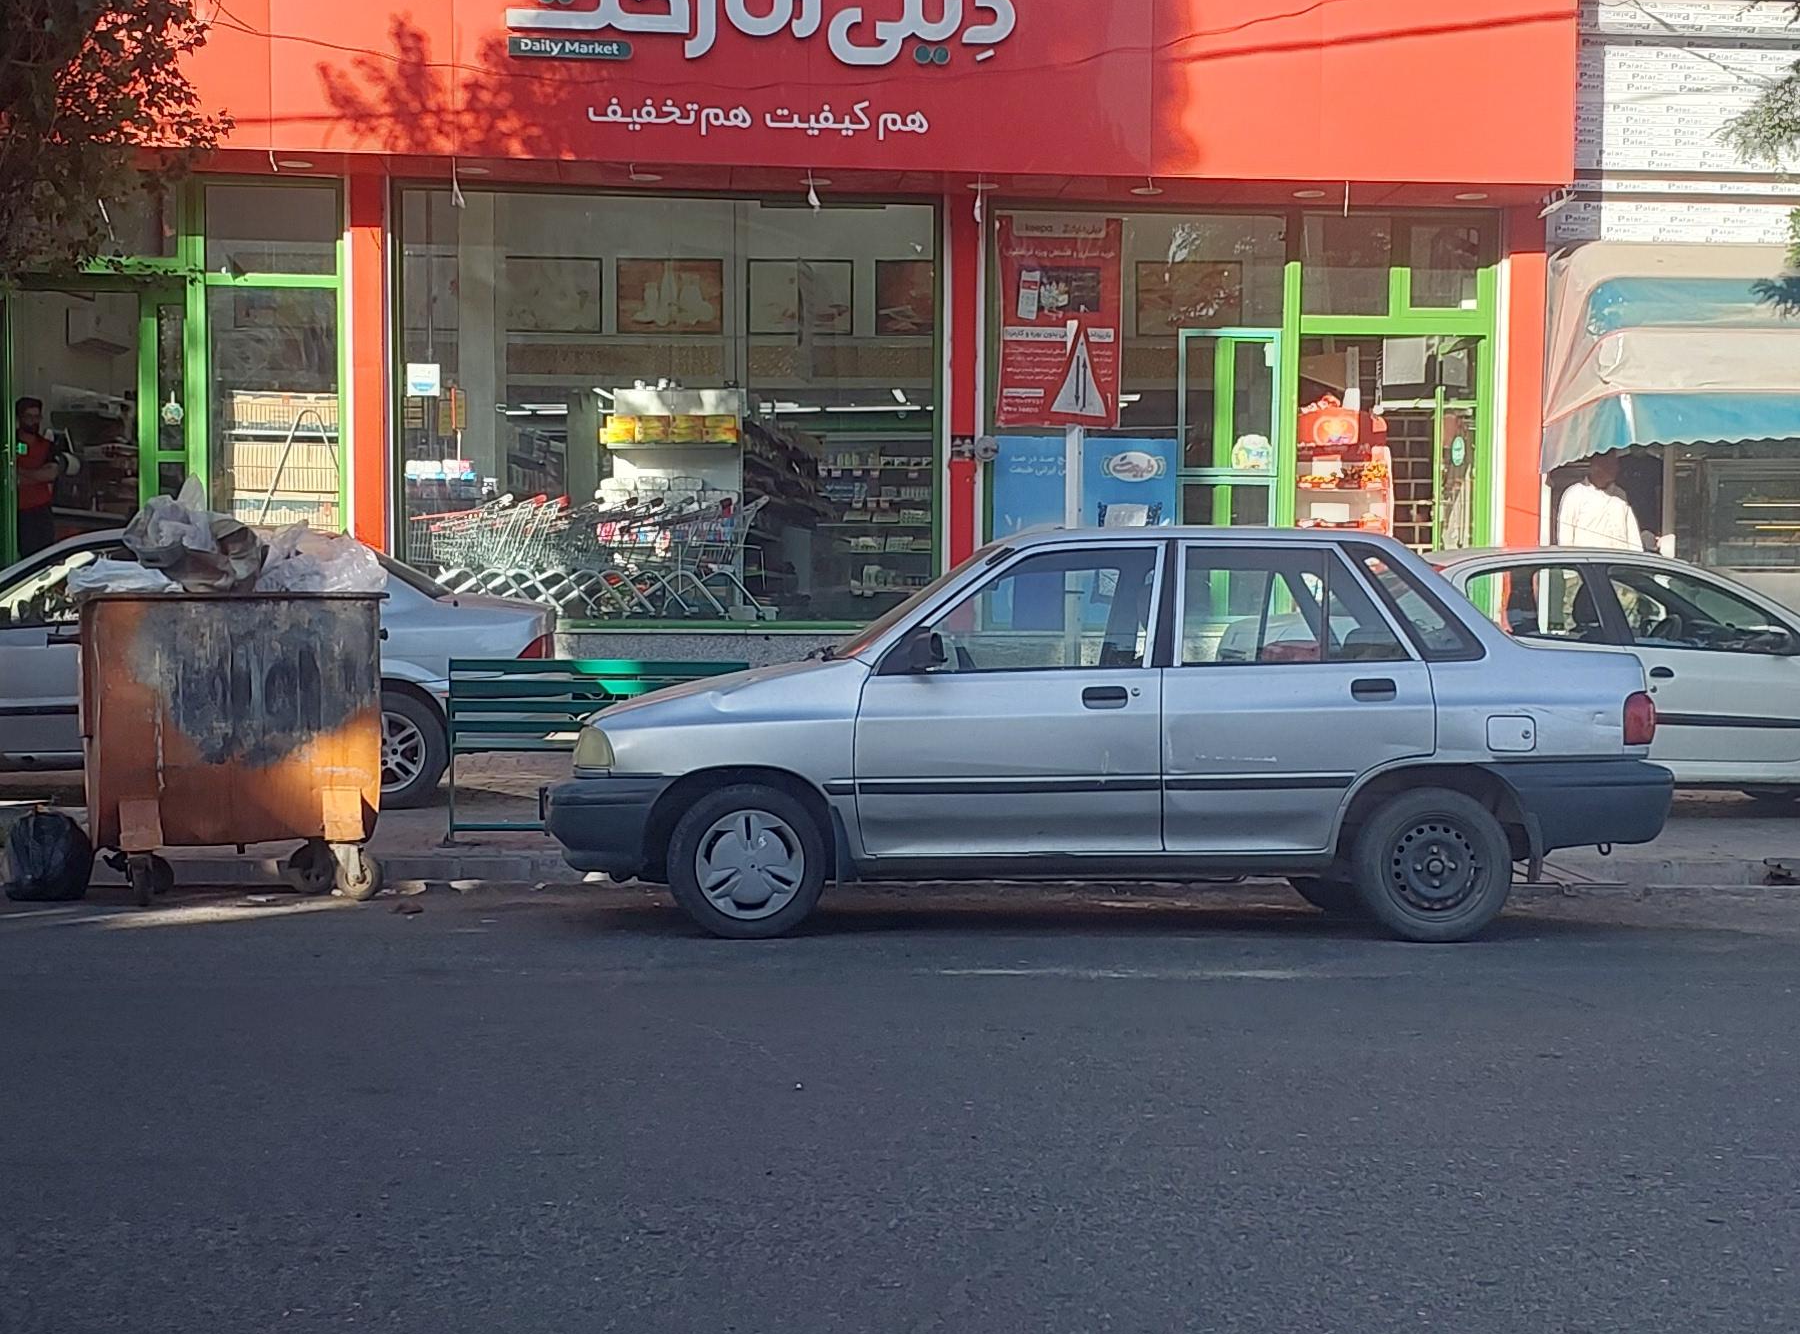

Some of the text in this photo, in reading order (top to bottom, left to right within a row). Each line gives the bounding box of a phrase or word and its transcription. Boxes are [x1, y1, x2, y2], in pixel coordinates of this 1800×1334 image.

[520, 38, 619, 55] Daily Market
[587, 97, 929, 140] هم کیفیت هم تخفیف
